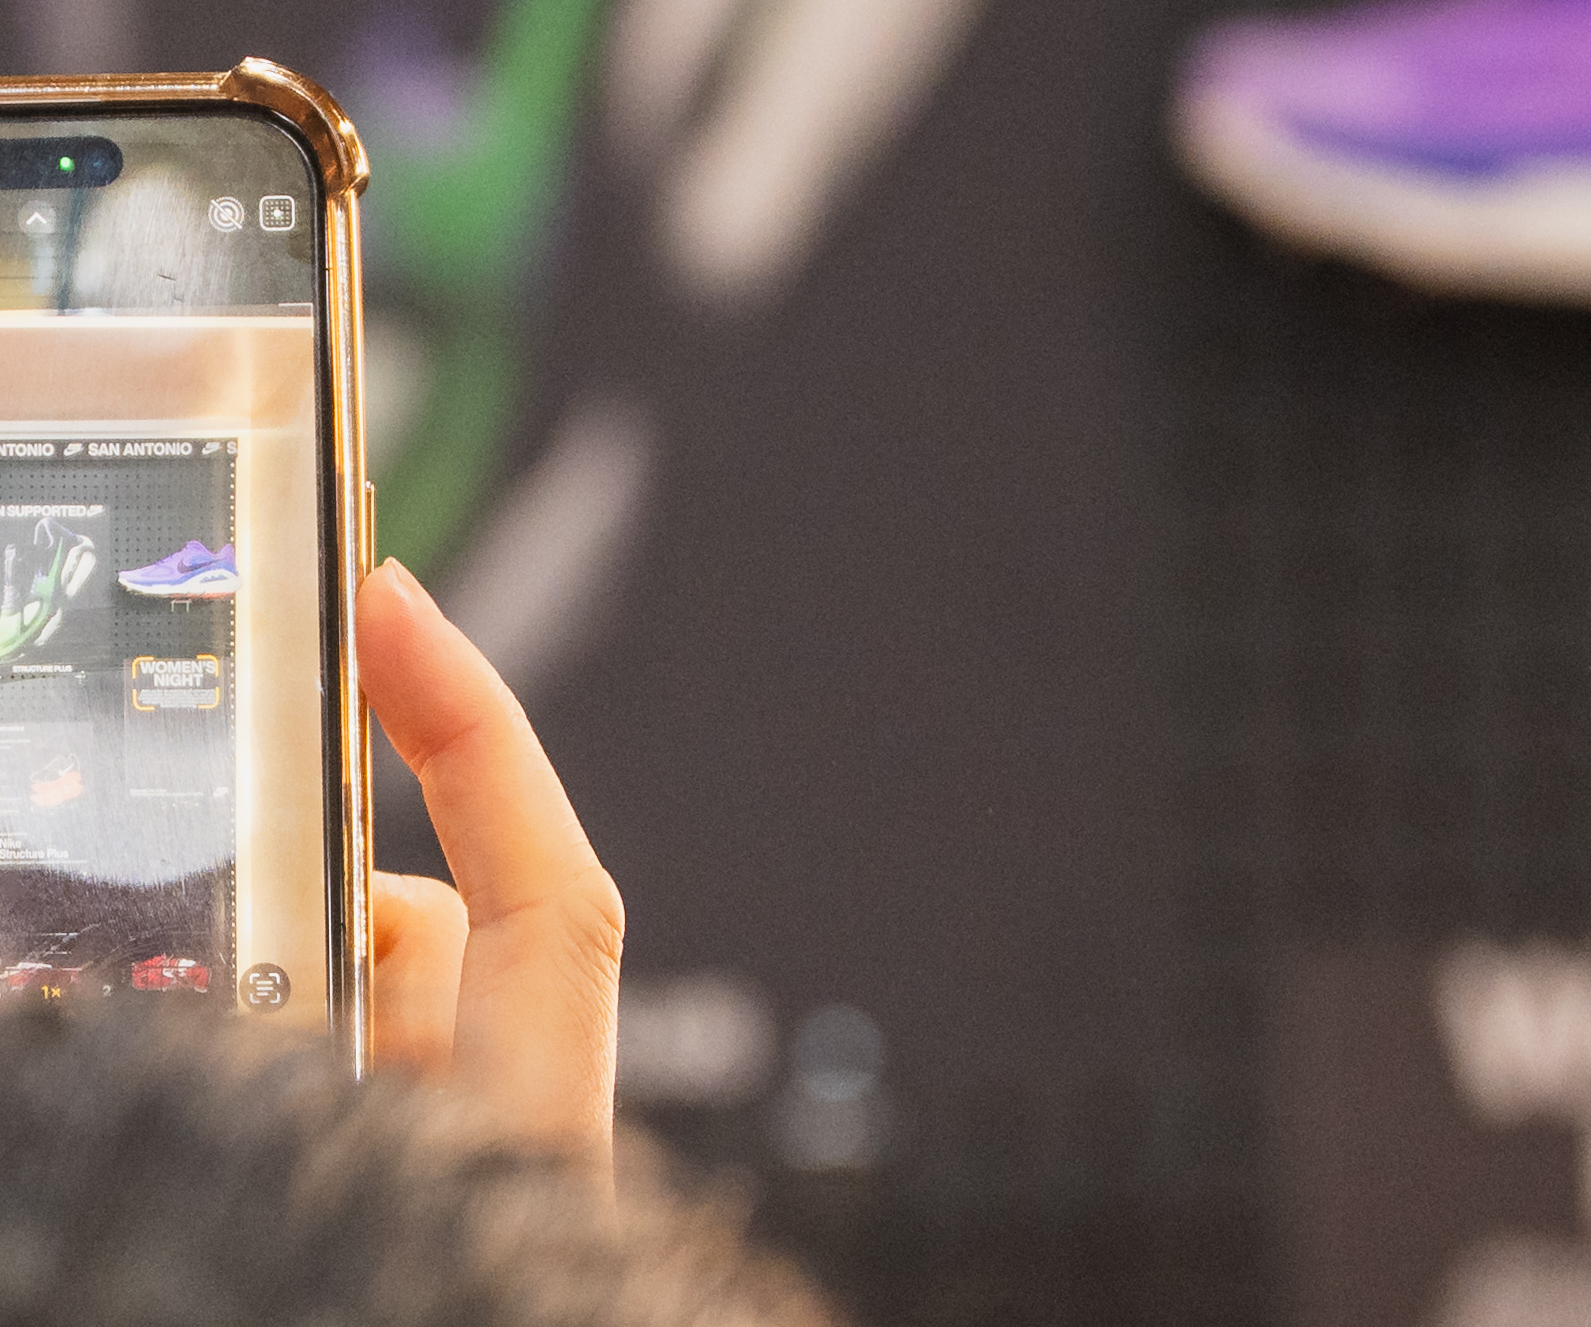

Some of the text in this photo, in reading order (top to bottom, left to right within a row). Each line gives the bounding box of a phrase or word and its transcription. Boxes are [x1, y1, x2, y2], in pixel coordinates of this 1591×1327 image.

[88, 442, 193, 456] SAN ANTONIO
[7, 504, 87, 517] SUPPORTED
[139, 660, 215, 674] WOMEN'S
[153, 674, 204, 687] NIGHT
[46, 847, 69, 858] Plus
